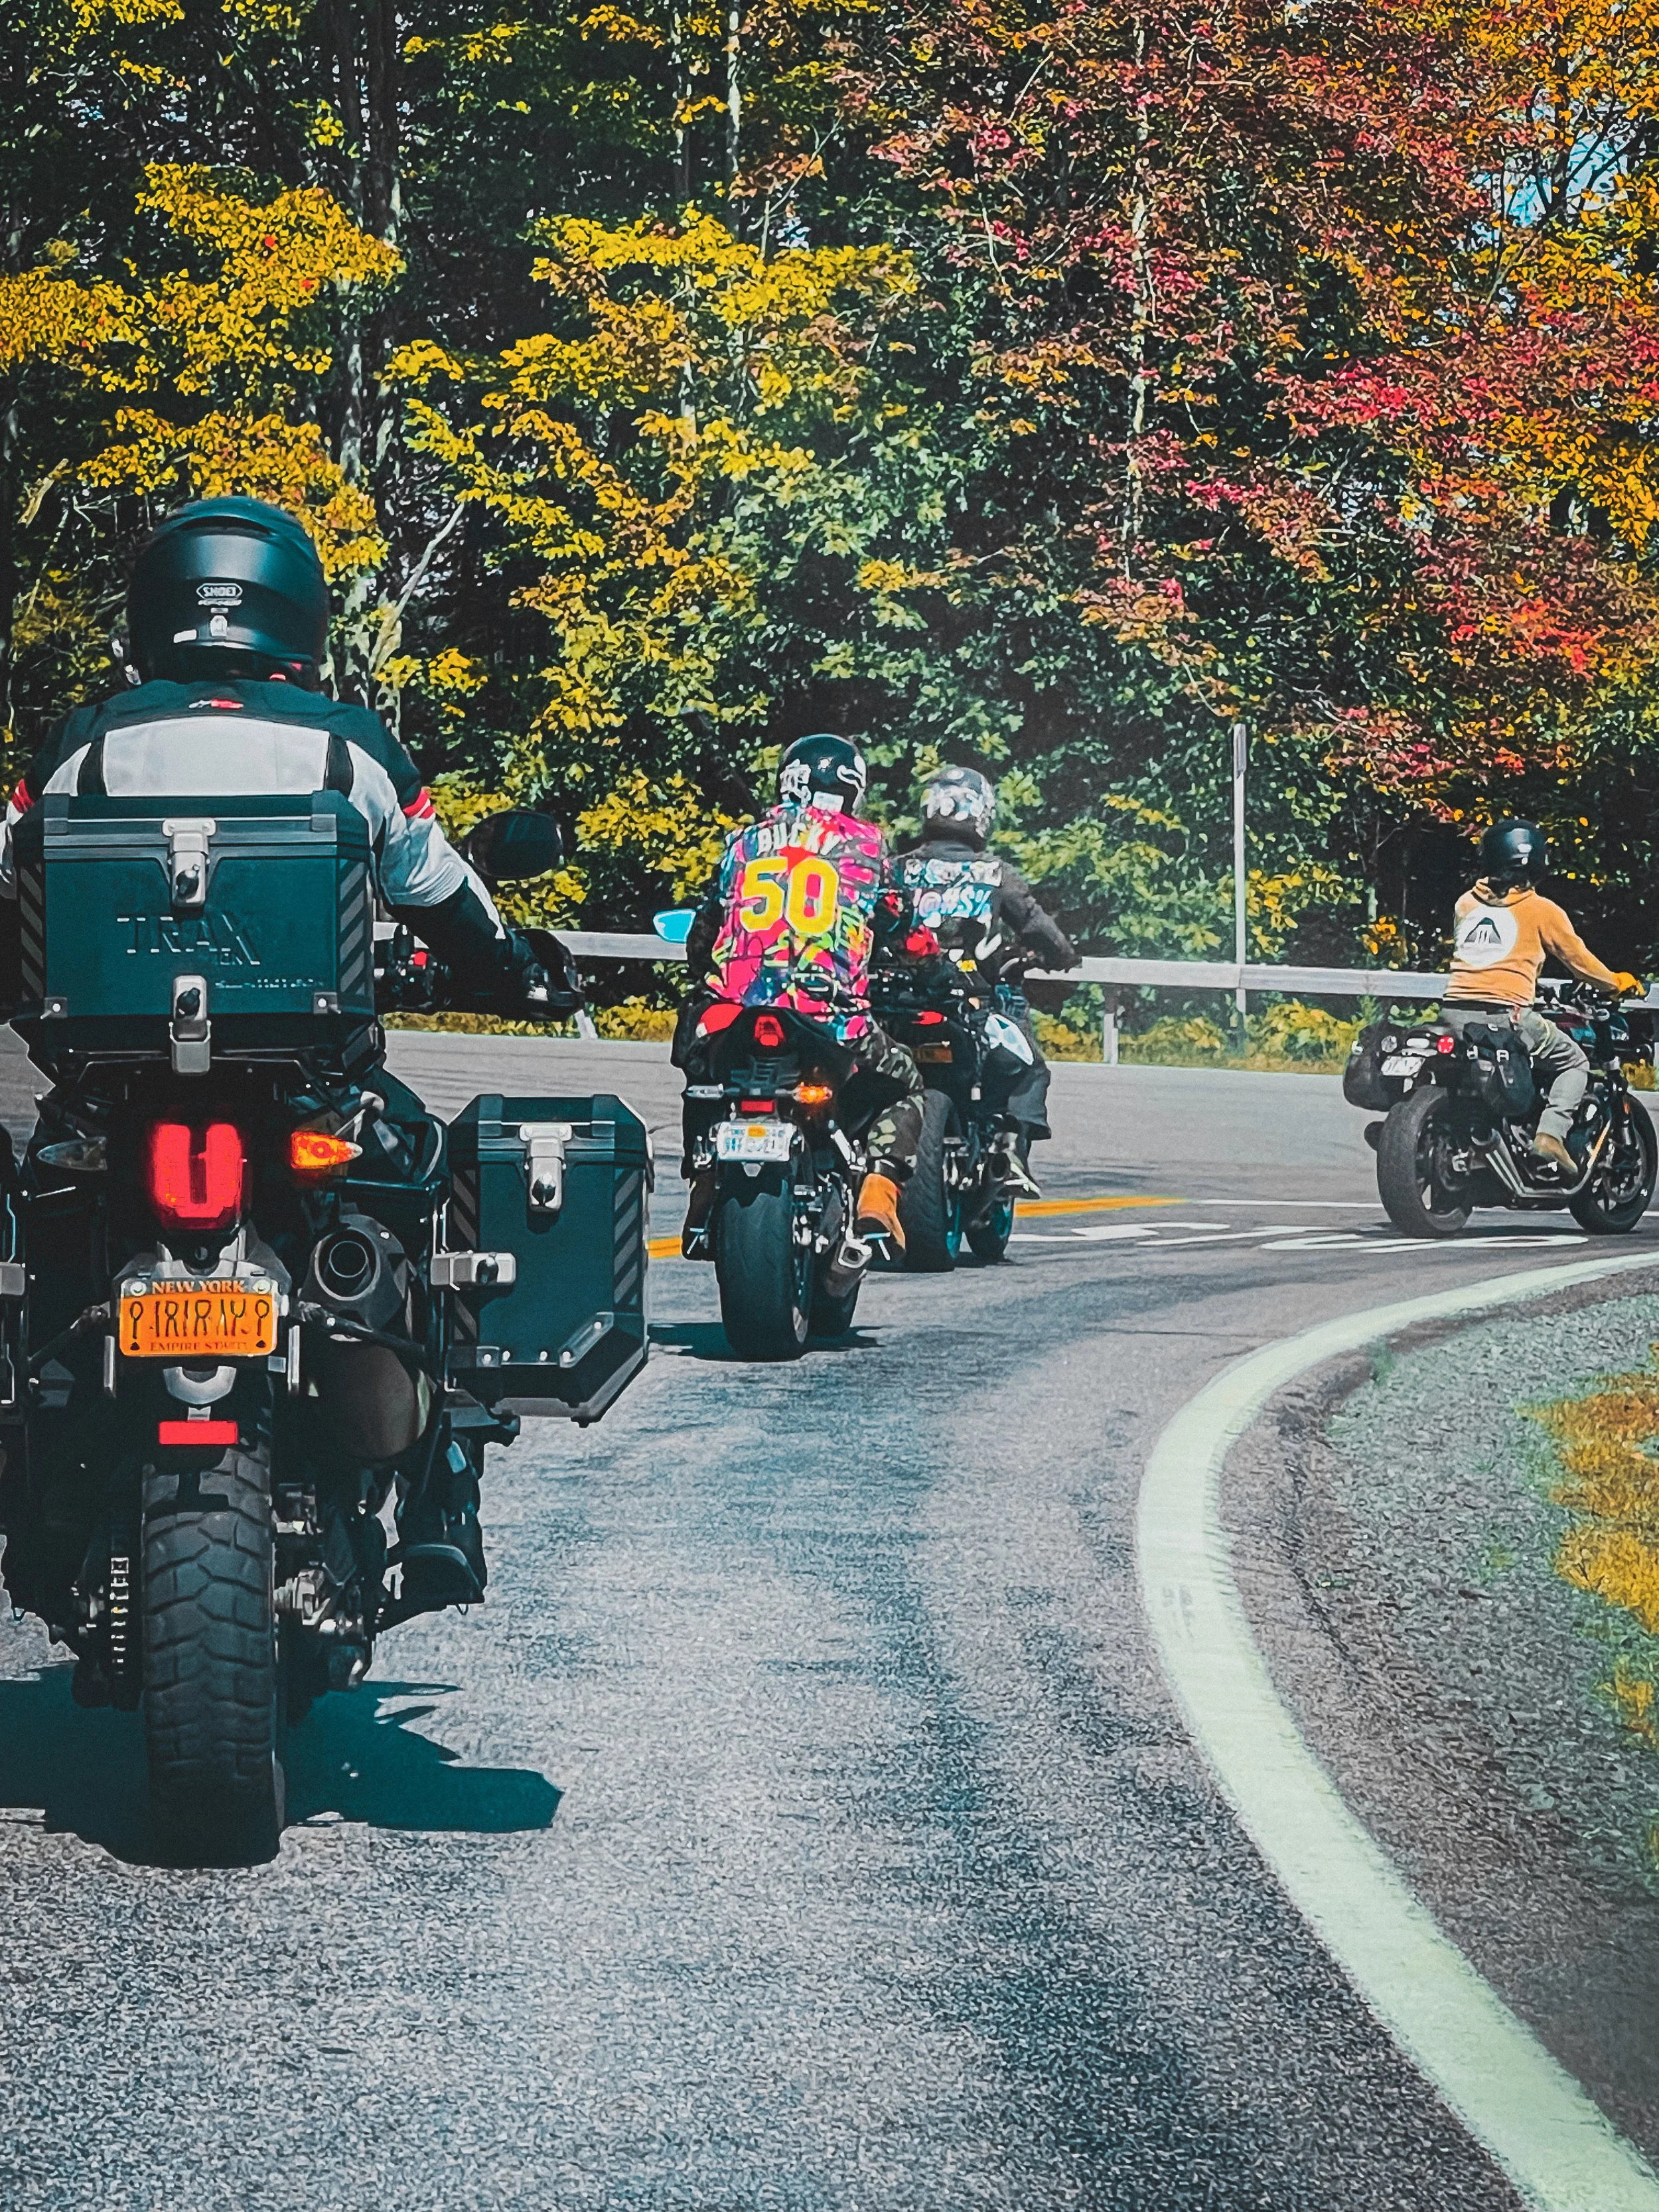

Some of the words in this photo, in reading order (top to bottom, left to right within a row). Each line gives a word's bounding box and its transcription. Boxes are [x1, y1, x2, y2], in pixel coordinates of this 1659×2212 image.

[757, 822, 841, 856] BUCKY
[739, 857, 840, 935] 50
[152, 1281, 194, 1294] NEW
[200, 1280, 246, 1293] YORK
